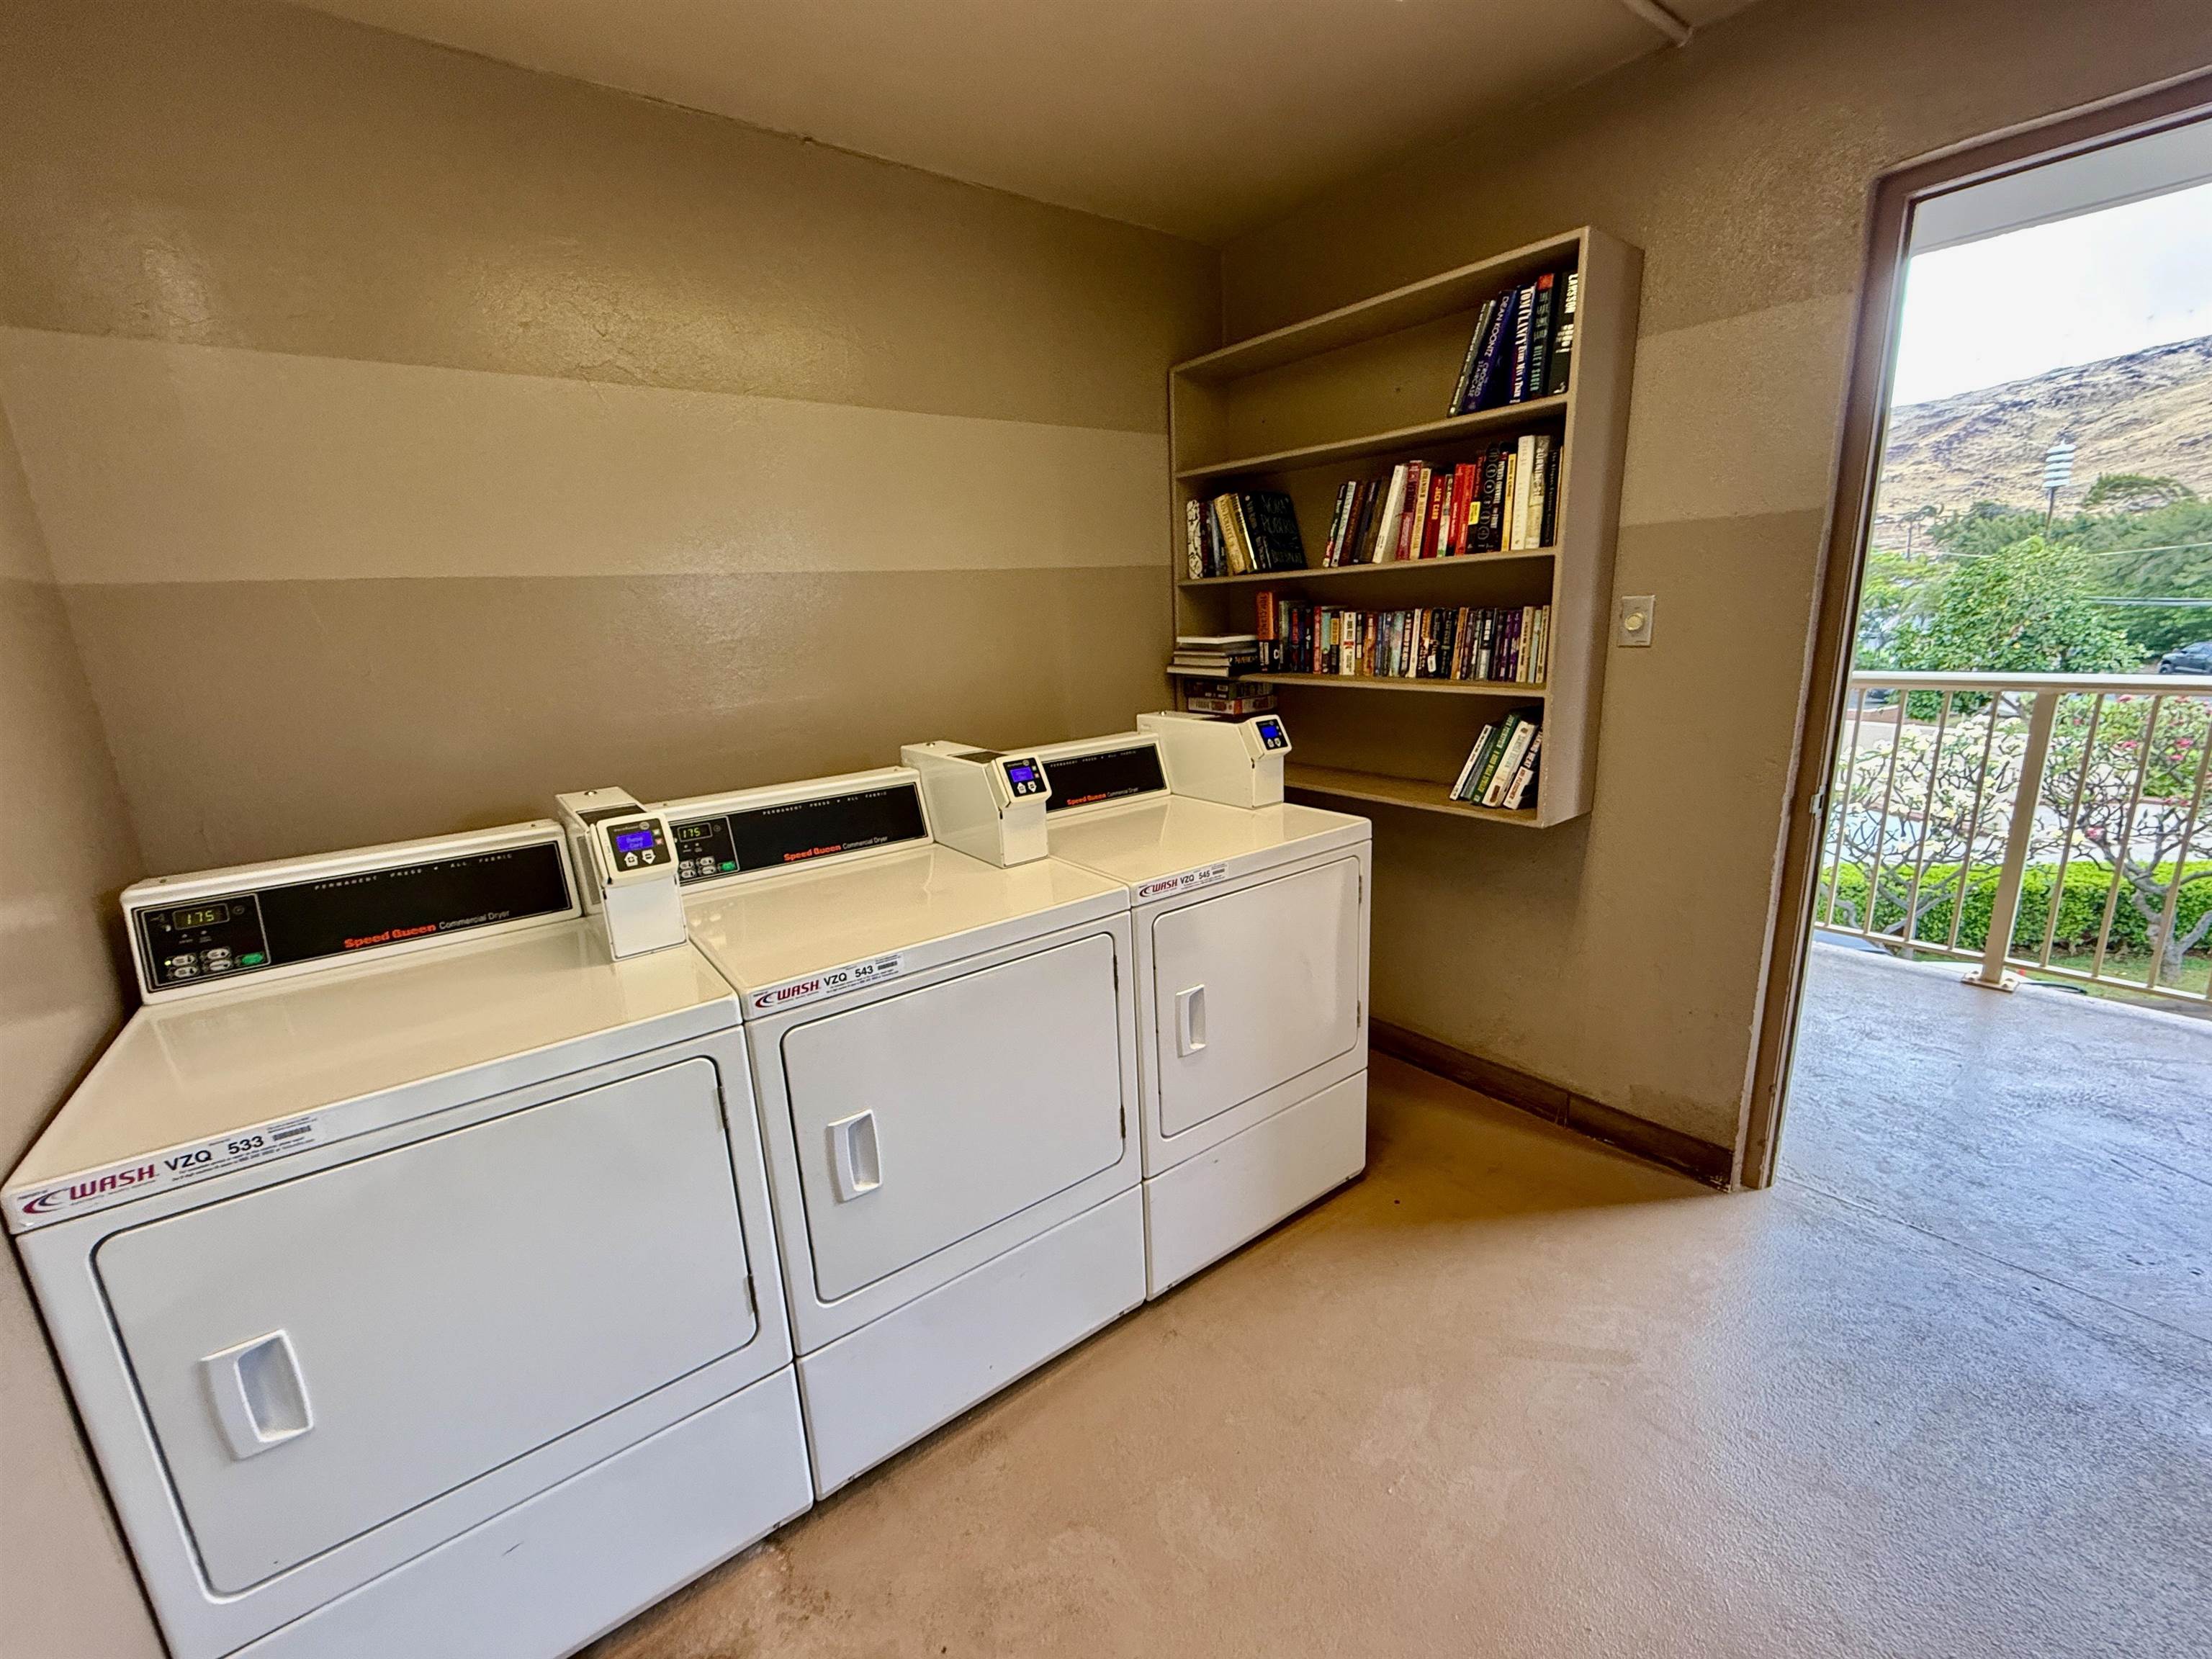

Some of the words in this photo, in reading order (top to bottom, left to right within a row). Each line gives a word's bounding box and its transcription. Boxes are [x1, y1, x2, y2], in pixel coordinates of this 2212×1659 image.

[1496, 296, 1509, 321] DEAN
[1484, 323, 1501, 357] KOONTZ
[683, 828, 701, 839] 175
[783, 848, 813, 862] Speed
[814, 844, 842, 855] Queen
[842, 837, 873, 850] Commercial
[1151, 878, 1179, 893] WASH
[1180, 874, 1195, 884] VZQ
[1198, 870, 1210, 880] 545
[187, 910, 215, 925] 175
[344, 930, 390, 948] Speed
[392, 924, 436, 939] Queen
[439, 913, 487, 930] Commercial
[487, 909, 510, 922] Dryer
[777, 979, 820, 1001] WASH
[823, 972, 848, 986] VZQ
[855, 965, 874, 979] 543
[69, 1164, 157, 1200] WASH
[163, 1149, 212, 1172] VZQ
[227, 1136, 264, 1155] 533
